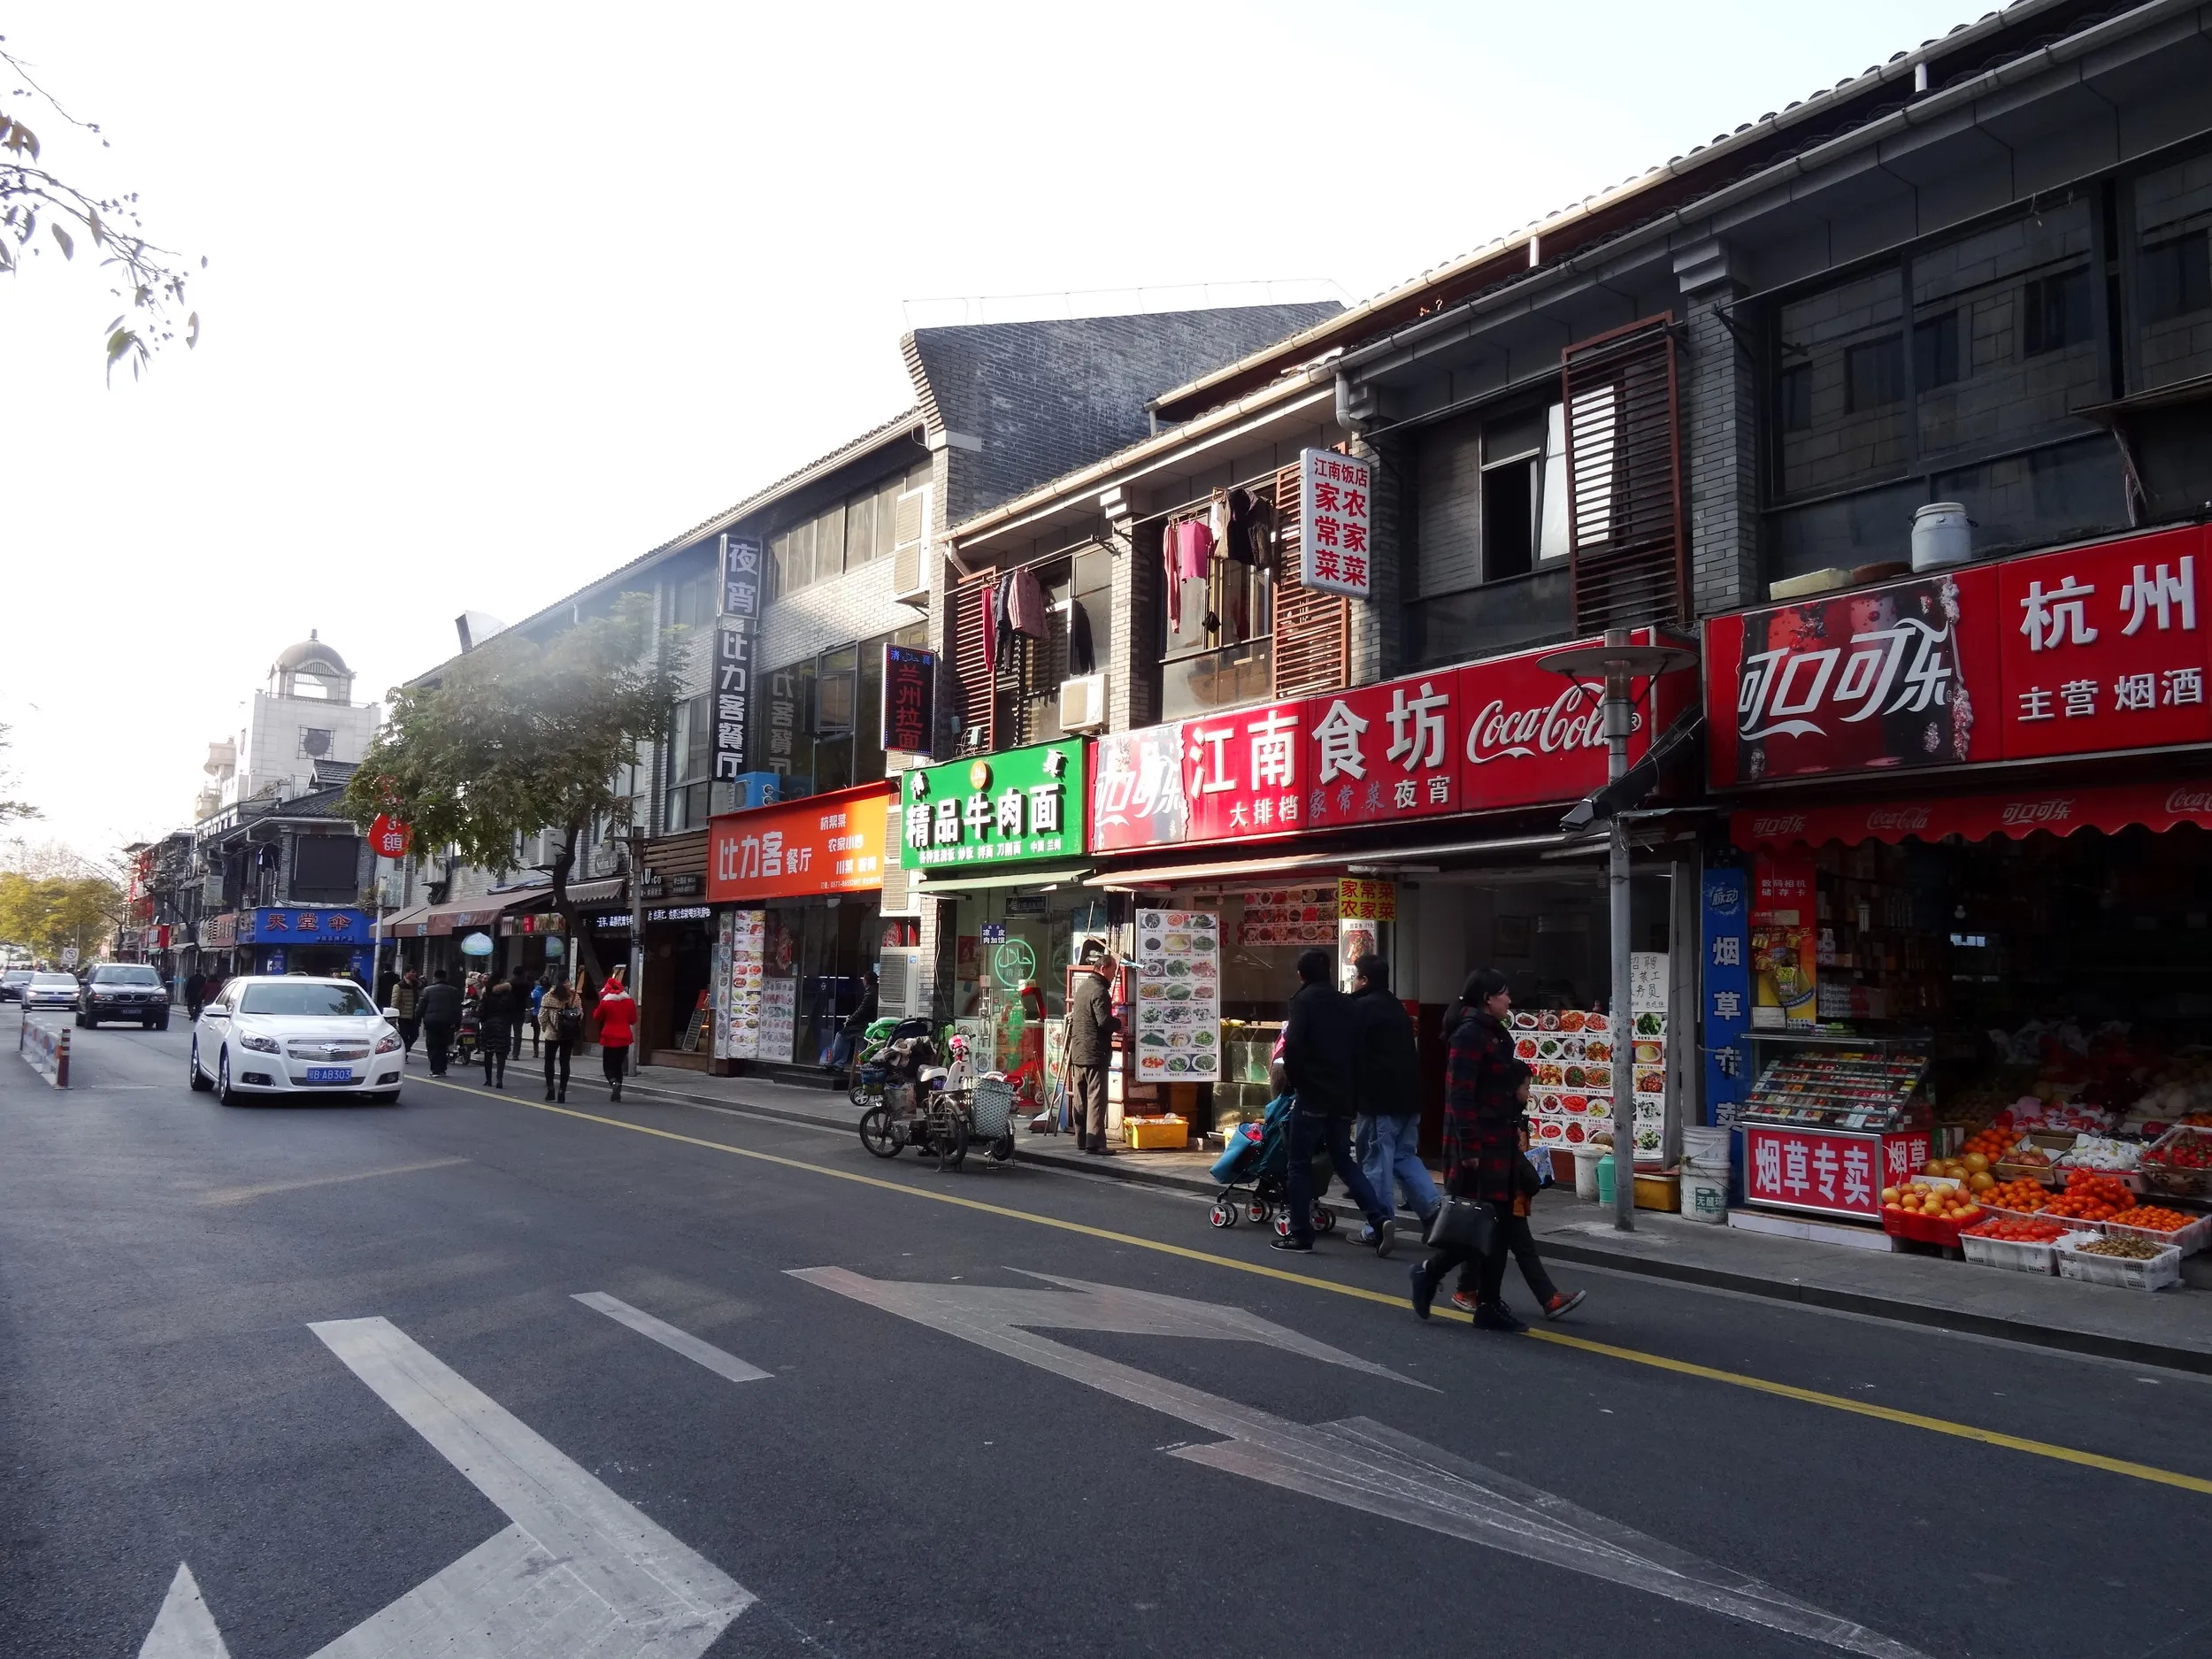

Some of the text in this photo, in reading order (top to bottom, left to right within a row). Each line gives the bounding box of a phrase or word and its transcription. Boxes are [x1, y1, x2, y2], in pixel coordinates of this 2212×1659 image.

[1314, 457, 1368, 488] 江南饭店
[1315, 482, 1340, 581] 家常菜
[1342, 489, 1367, 587] 农家菜
[728, 543, 758, 613] 夜宵
[2020, 556, 2196, 652] 杭州
[718, 632, 748, 778] 比力客餐厅
[1738, 618, 1951, 741] 可口可乐
[2017, 667, 2202, 722] 主营 烟酒
[895, 664, 924, 749] 兰州拉面
[1190, 682, 1449, 799] 江南食坊
[905, 782, 1060, 849] 精品牛肉面
[1229, 795, 1299, 828] 大排档
[1394, 775, 1451, 810] 夜宵
[1752, 813, 1809, 839] 可口可乐
[1866, 797, 1933, 831] Coca-Cola
[2001, 797, 2077, 826] 可口可乐
[718, 831, 812, 882] 比力客 餐厅
[1340, 899, 1395, 920] 农家菜
[1341, 879, 1395, 901] 家常菜
[1761, 879, 1807, 888] 数码相机
[1761, 887, 1807, 897] 储存卡
[265, 912, 352, 932] 天堂伞
[982, 928, 1005, 937] 凉皮
[1755, 1136, 1870, 1207] 烟草专卖
[1888, 1138, 1927, 1175] 烟草
